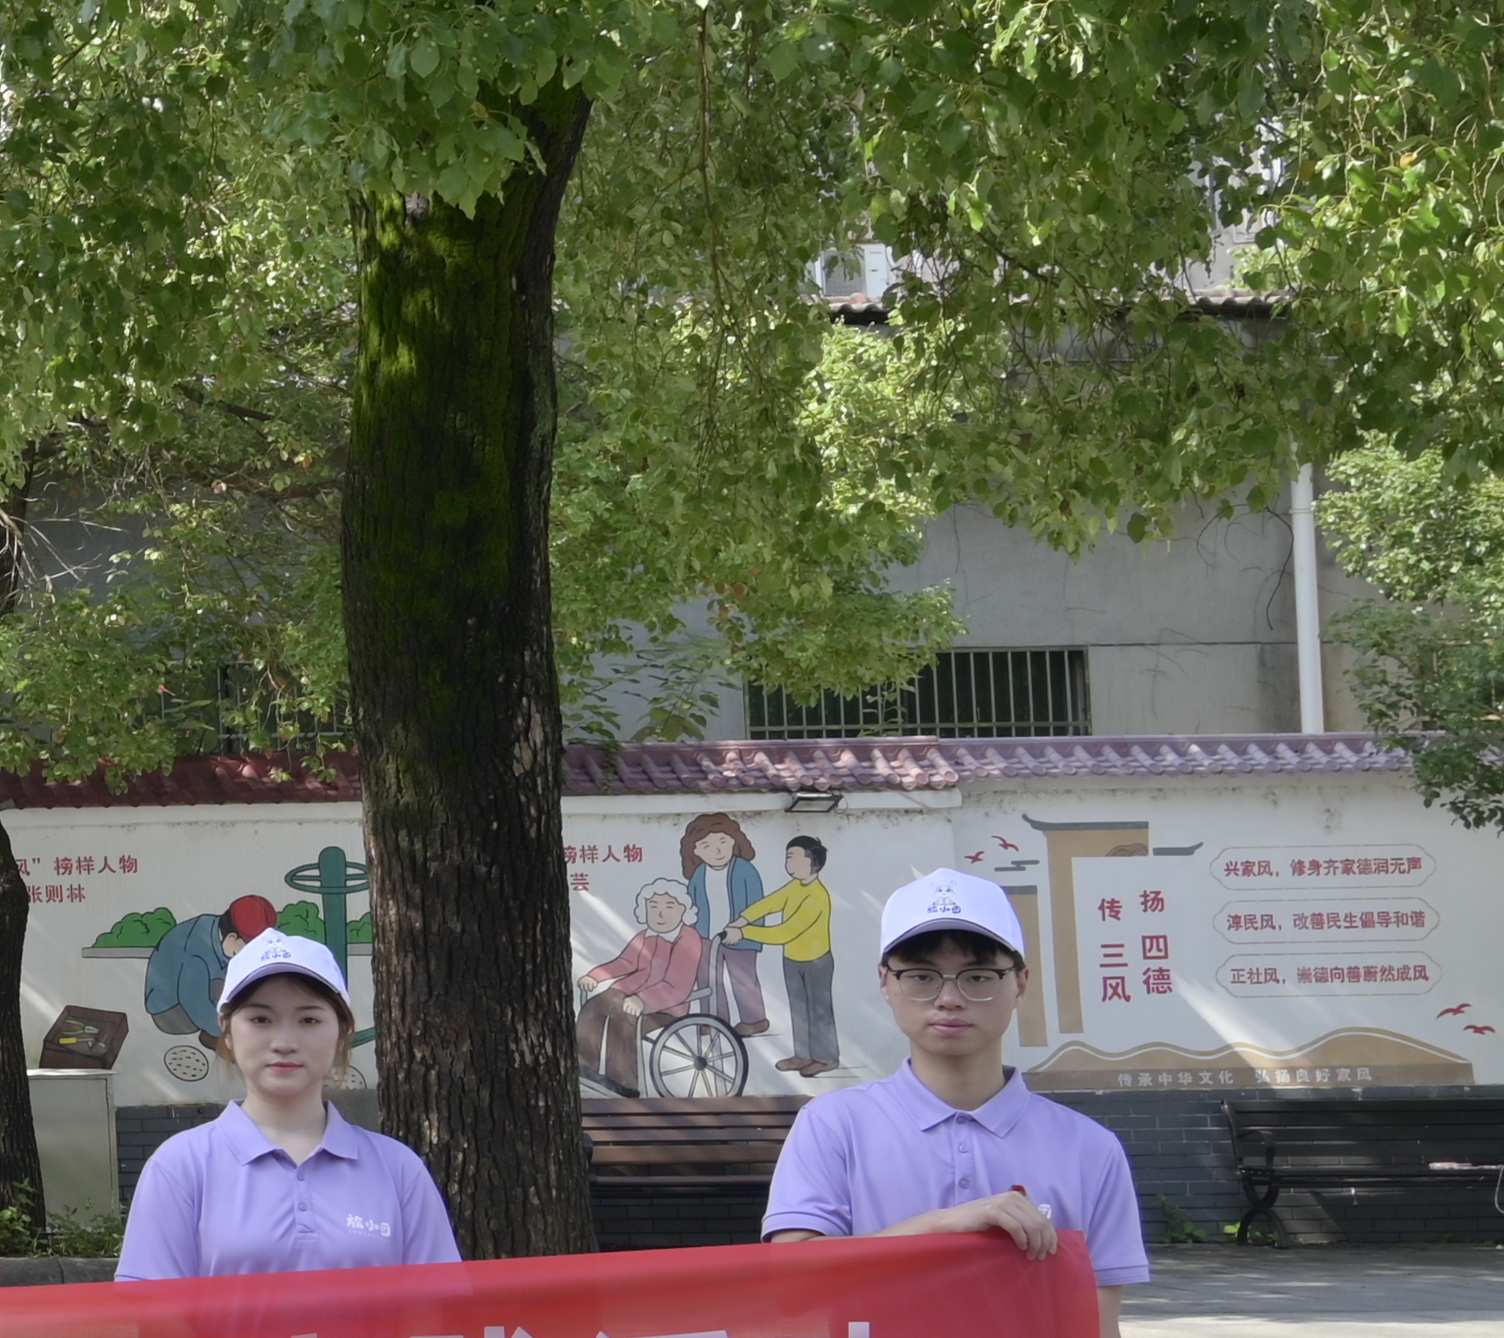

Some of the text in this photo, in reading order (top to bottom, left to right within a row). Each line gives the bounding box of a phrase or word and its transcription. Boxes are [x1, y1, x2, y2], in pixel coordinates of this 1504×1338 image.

[1224, 856, 1423, 878] 兴家风，修身齐家德润无声
[1117, 1067, 1373, 1088] 传承中华文化 弘扬良好家风
